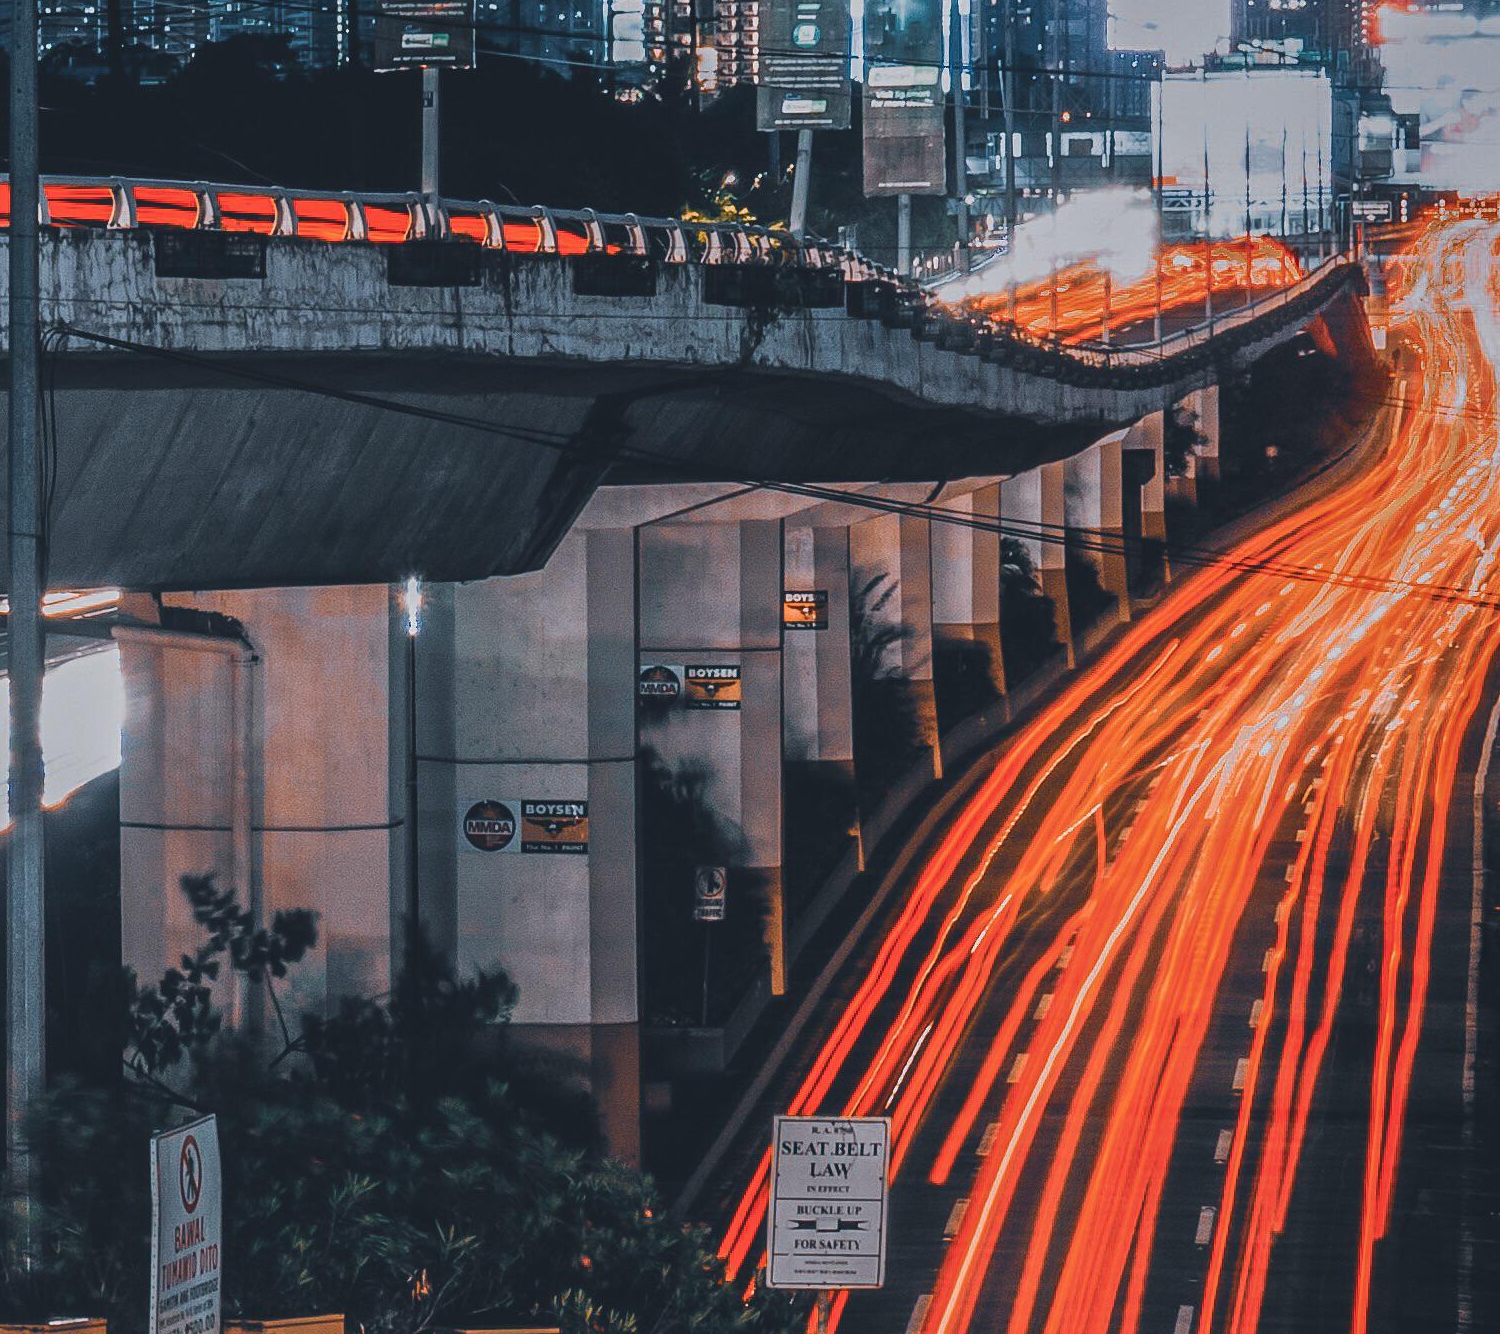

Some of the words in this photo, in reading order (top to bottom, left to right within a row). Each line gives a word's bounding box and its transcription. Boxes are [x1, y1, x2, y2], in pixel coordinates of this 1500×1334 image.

[688, 669, 738, 678] BOYSEN
[640, 683, 678, 693] MMDA
[525, 804, 584, 815] BOYSEN
[467, 820, 512, 834] MMDA
[781, 1140, 830, 1156] SEAT
[831, 1141, 882, 1157] BELT
[810, 1162, 852, 1180] LAW
[807, 1185, 816, 1193] IN
[818, 1185, 850, 1193] EFFECT
[797, 1205, 845, 1215] BUCKLE
[847, 1206, 862, 1216] UP
[174, 1215, 205, 1254] BAWAL
[794, 1239, 817, 1250] FOR
[819, 1239, 861, 1251] SAFETY
[162, 1251, 198, 1292] TUMAWID
[200, 1242, 218, 1276] DITO
